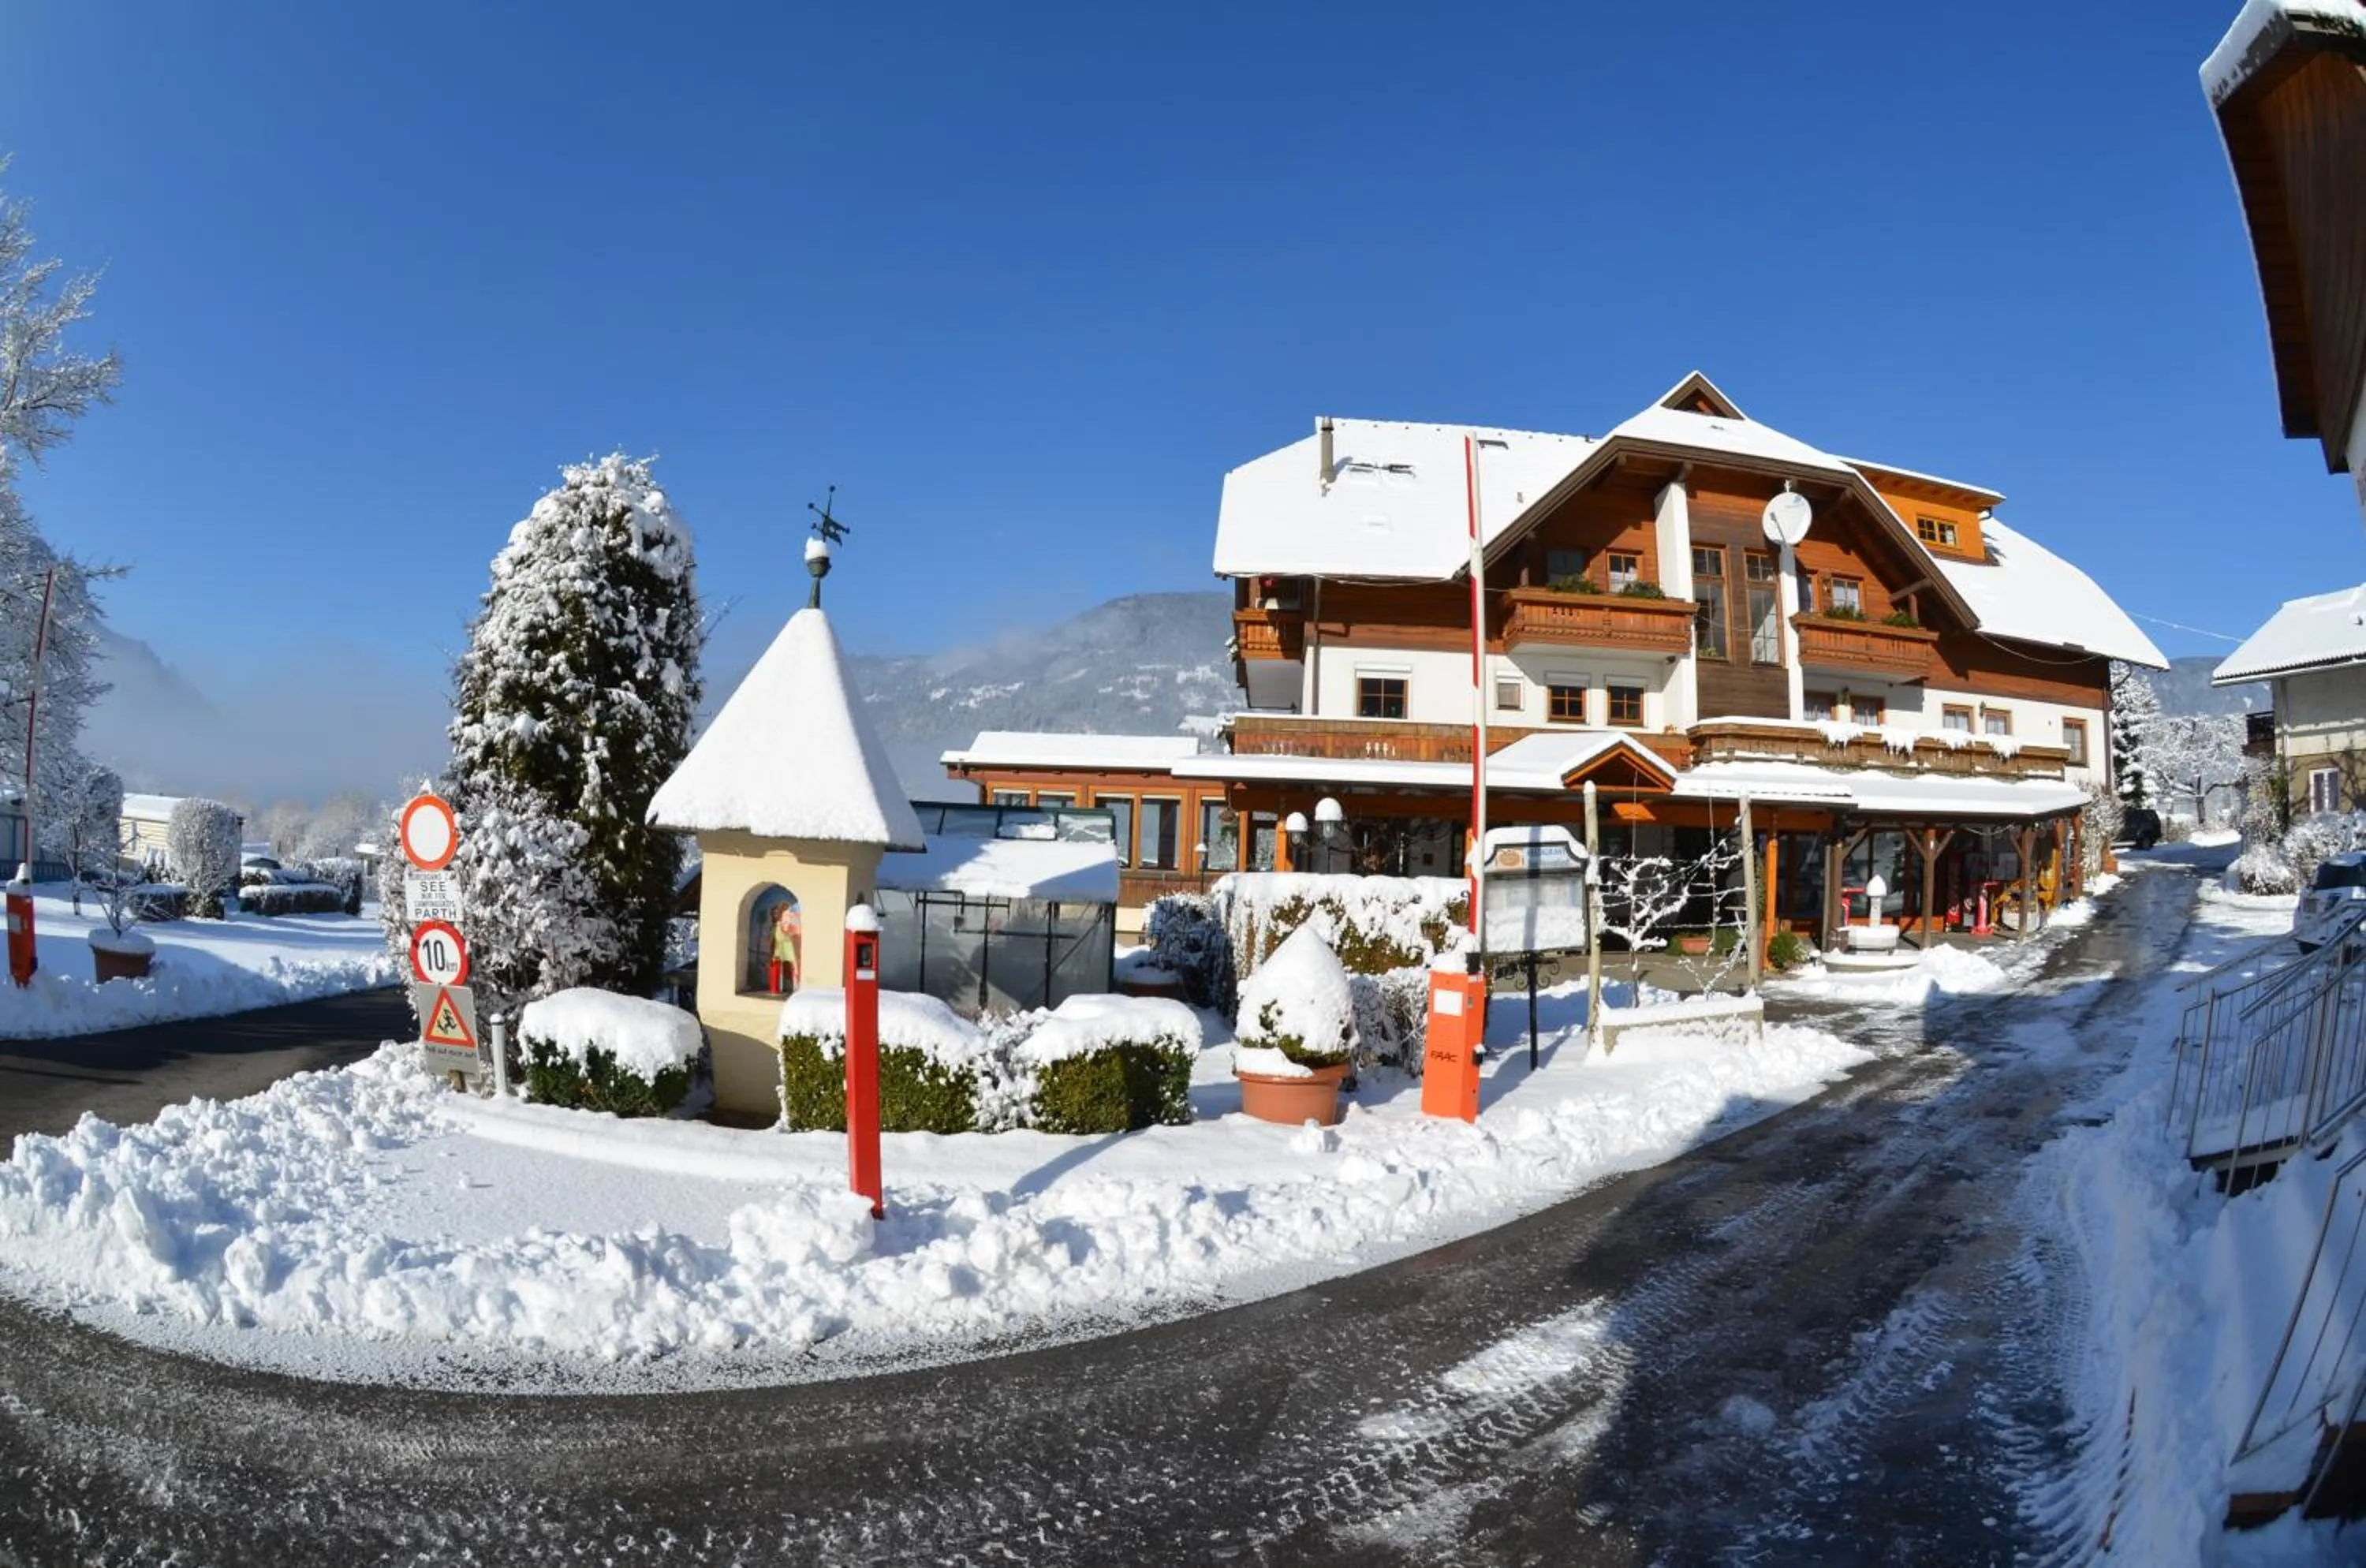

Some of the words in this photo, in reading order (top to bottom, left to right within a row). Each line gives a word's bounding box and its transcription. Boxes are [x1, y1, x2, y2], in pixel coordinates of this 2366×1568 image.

[421, 881, 446, 891] SEE
[415, 908, 457, 919] PARTH
[423, 939, 446, 972] 10
